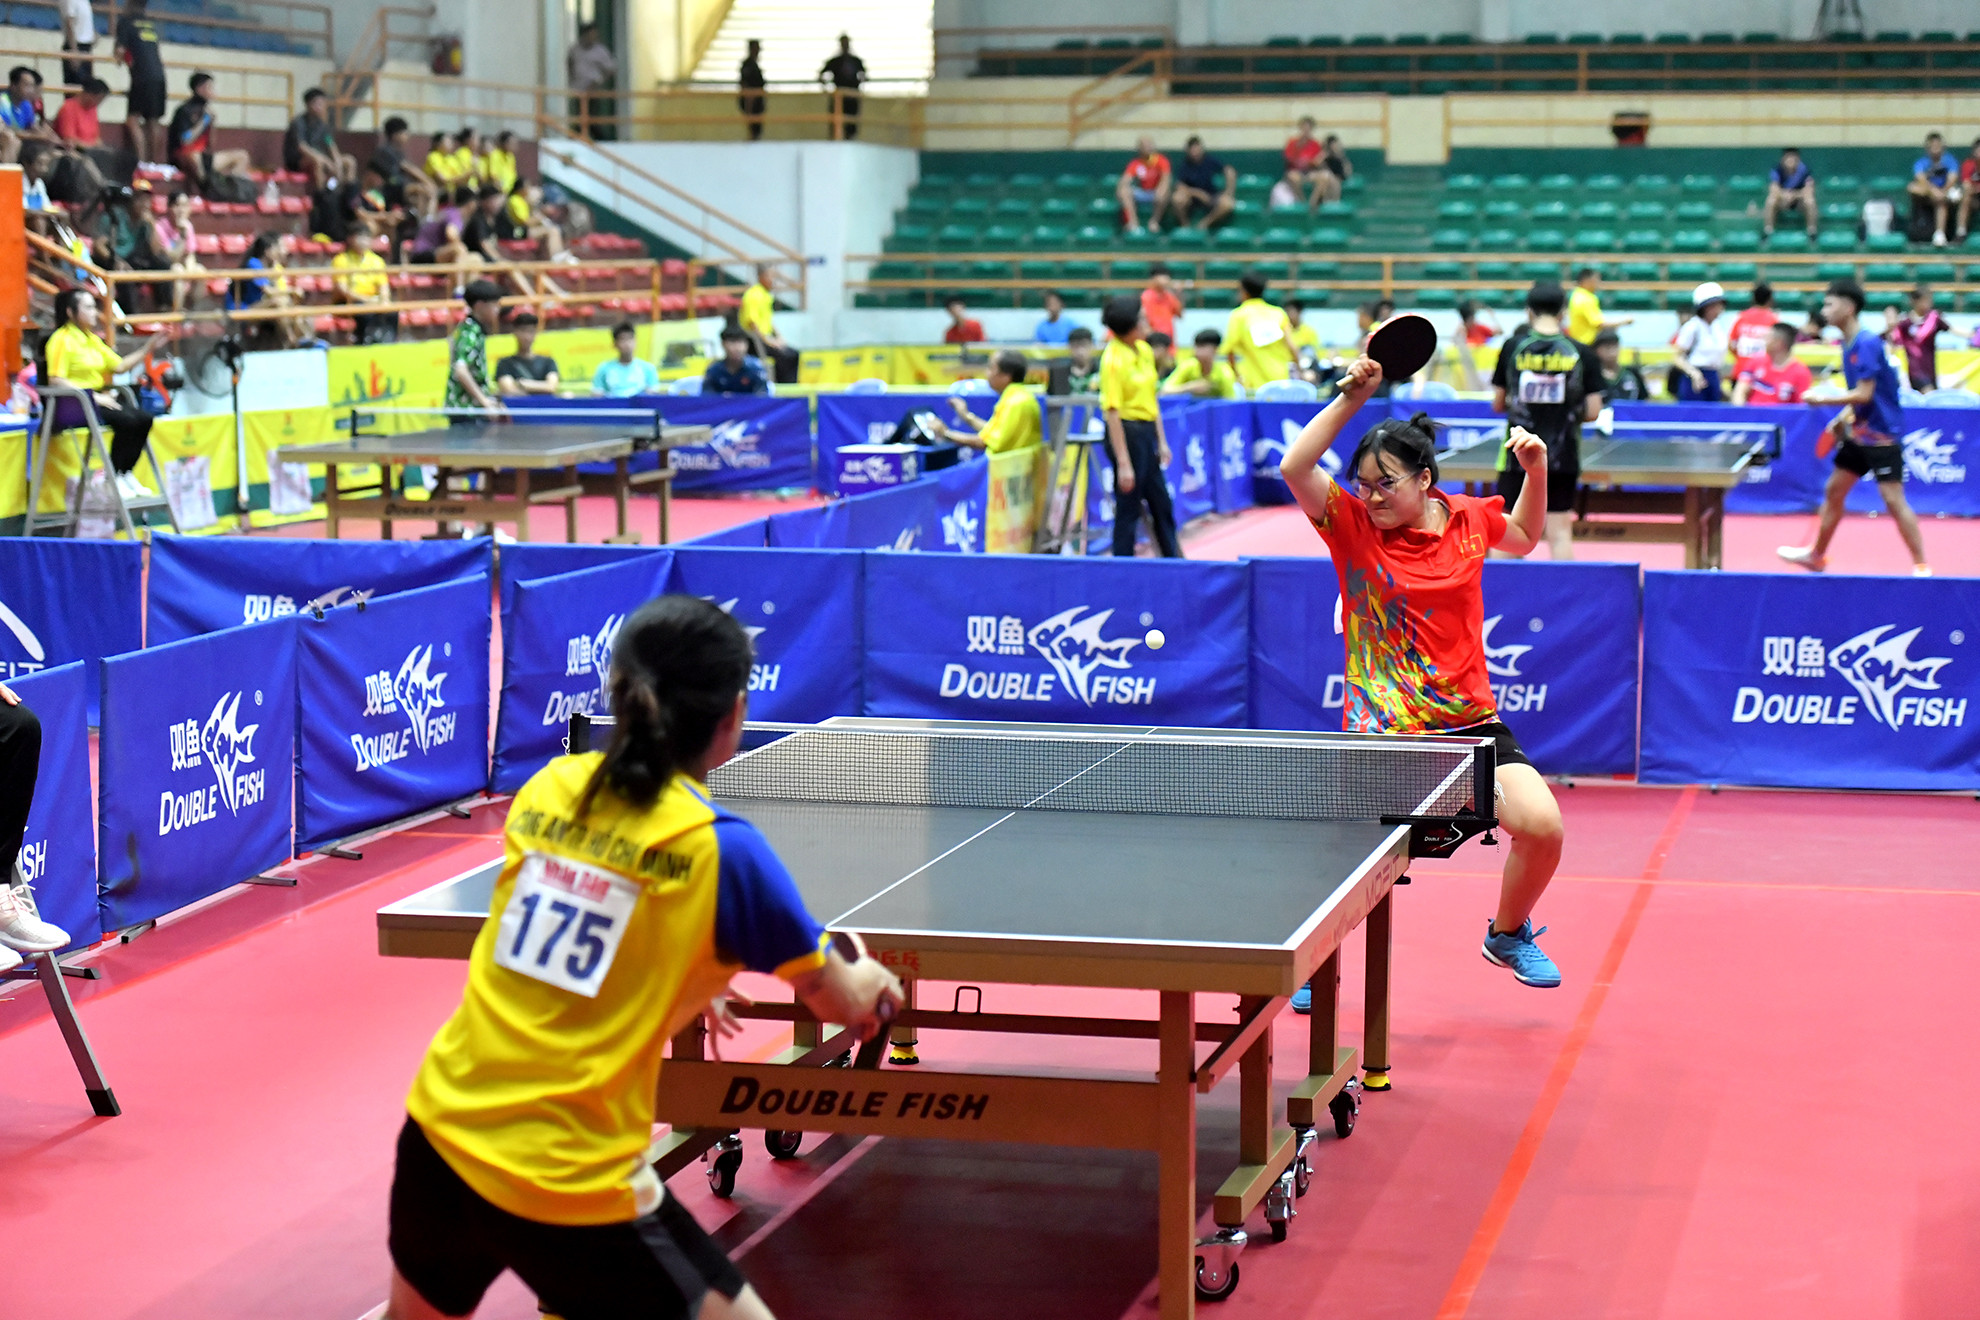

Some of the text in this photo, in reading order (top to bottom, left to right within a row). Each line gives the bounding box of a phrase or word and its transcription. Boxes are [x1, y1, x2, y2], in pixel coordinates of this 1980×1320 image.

[939, 663, 1157, 705] DOUBLE FISH
[1731, 686, 1968, 727] DOUBLE FISH
[351, 711, 457, 772] DOUBLE FISH
[159, 768, 265, 836] DOUBLE FISH
[510, 893, 614, 980] 175
[720, 1076, 989, 1120] DOUBLE FISH
